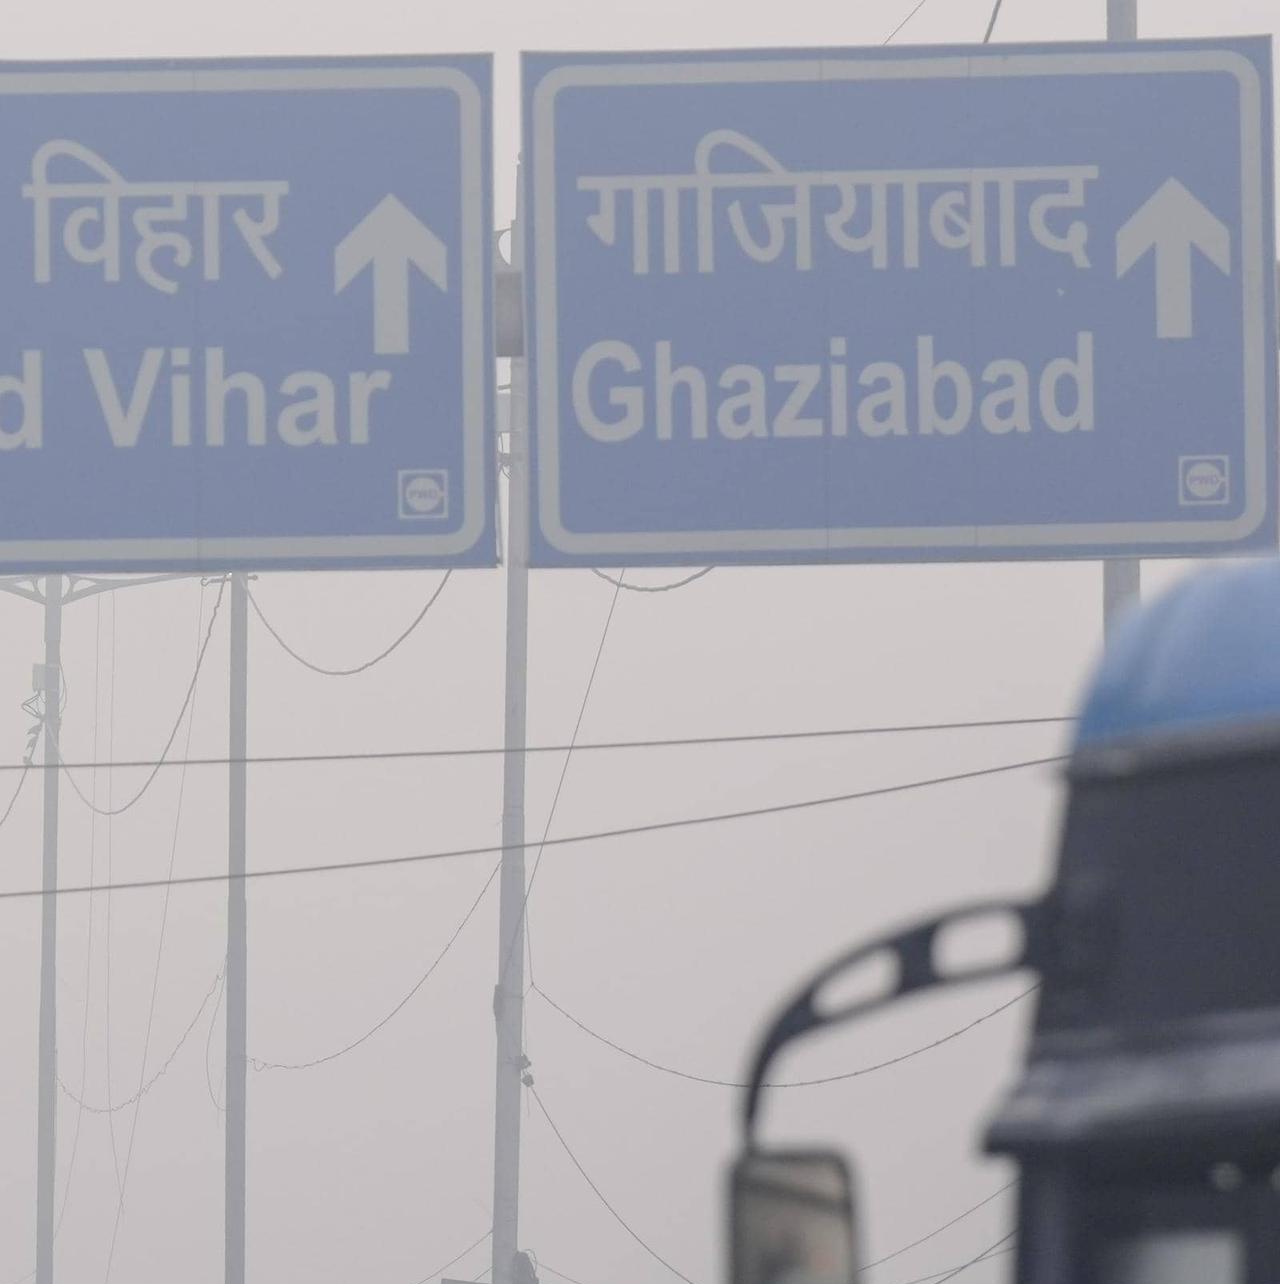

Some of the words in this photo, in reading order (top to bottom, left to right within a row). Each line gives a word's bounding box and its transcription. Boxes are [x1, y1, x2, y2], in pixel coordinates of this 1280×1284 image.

[23, 139, 289, 294] विहार
[577, 130, 1098, 274] गाजियाबाद
[83, 347, 392, 450] Vihar
[572, 331, 1094, 442] Ghaziabad
